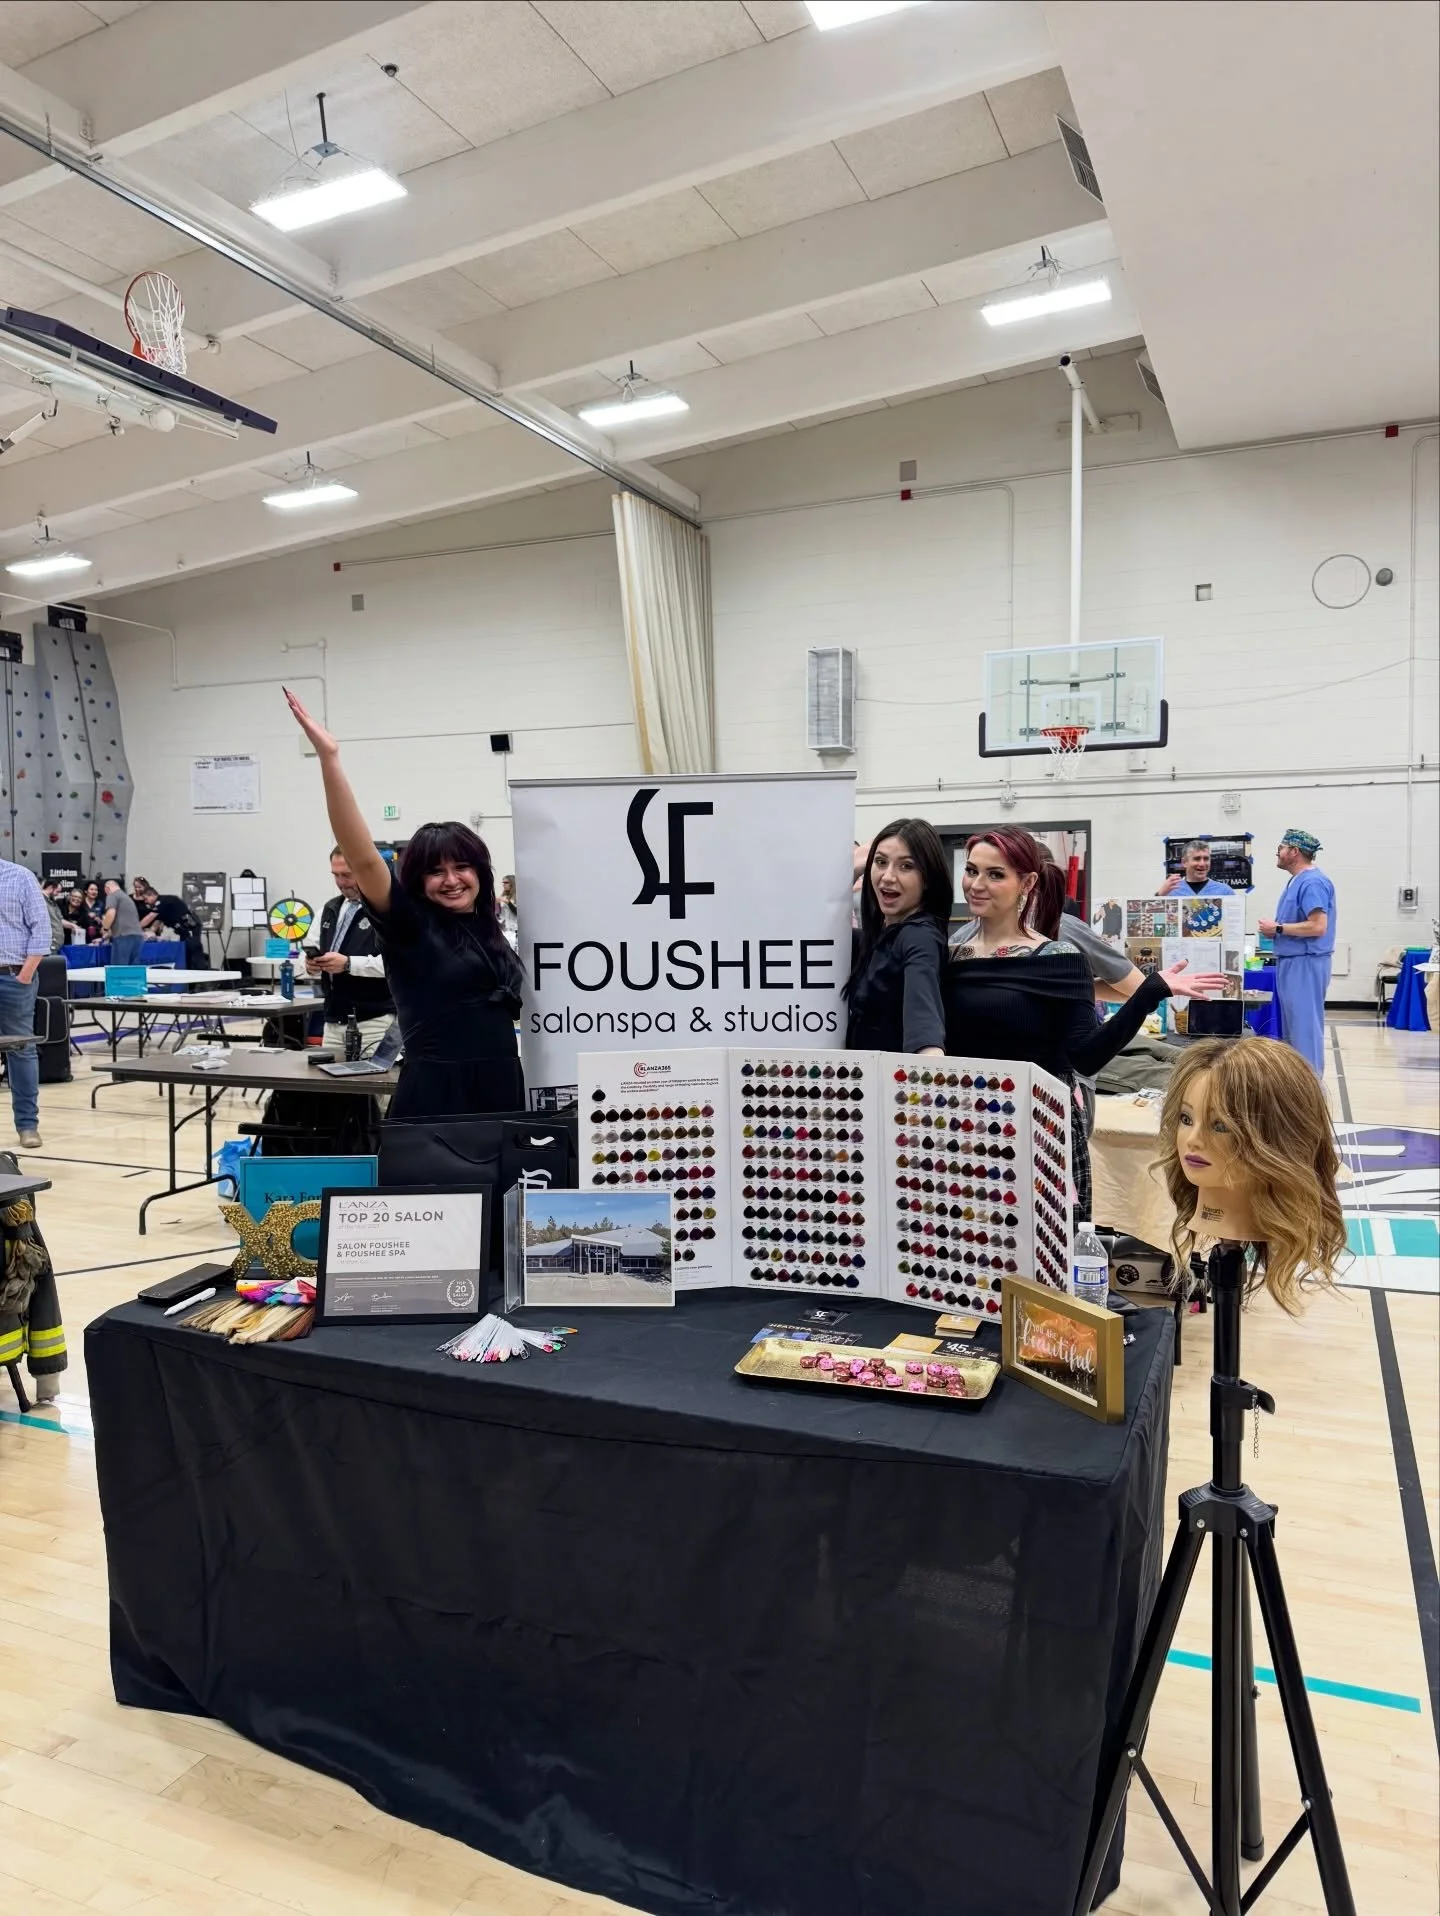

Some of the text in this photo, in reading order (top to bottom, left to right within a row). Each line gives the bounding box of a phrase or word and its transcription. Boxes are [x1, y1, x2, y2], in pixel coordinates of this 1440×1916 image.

[50, 869, 78, 877] Littleton
[533, 939, 836, 992] FOUSHEE
[530, 1004, 838, 1039] salonspa & studios
[338, 1210, 444, 1223] TOP 20 SALON
[337, 1241, 411, 1250] SALON FOUSHEE
[336, 1250, 343, 1258] &
[388, 1249, 406, 1257] SPA
[455, 1285, 467, 1293] 20
[1018, 1317, 1095, 1374] beautiful
